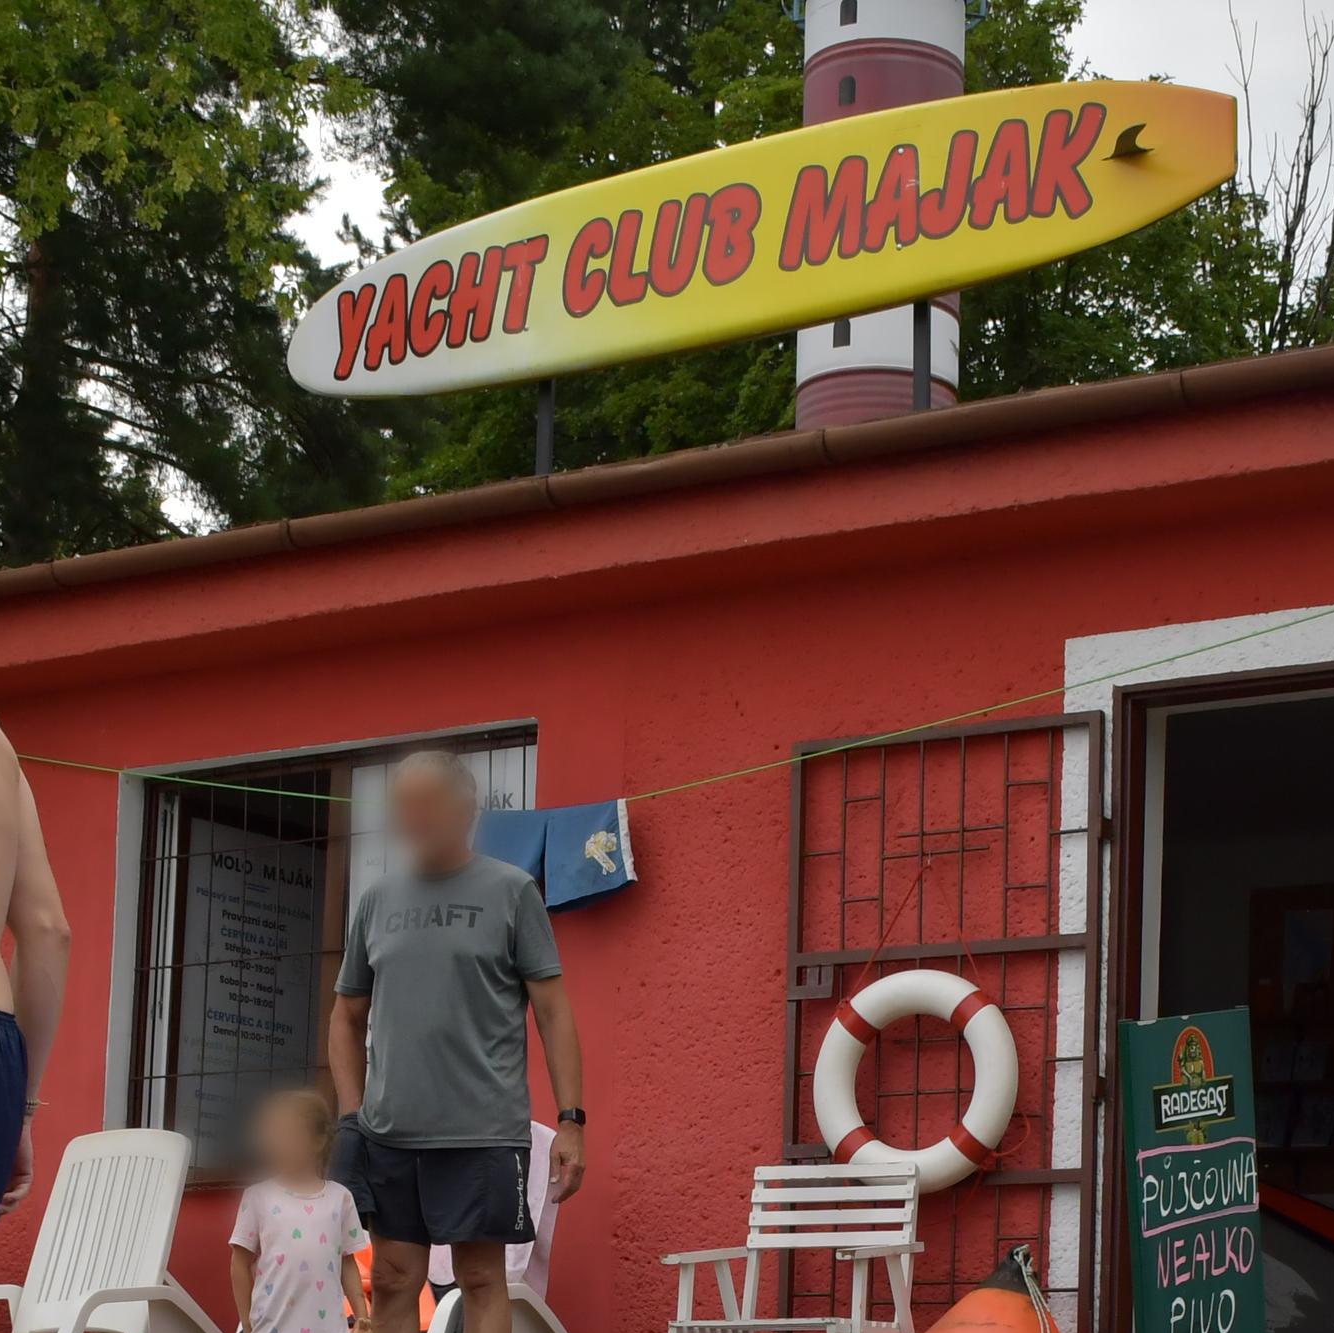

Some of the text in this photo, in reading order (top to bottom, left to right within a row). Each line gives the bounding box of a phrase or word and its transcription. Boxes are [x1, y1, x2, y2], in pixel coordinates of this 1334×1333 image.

[334, 101, 1108, 381] YACHT CLUB MAJAK
[212, 854, 253, 876] MOLO
[386, 904, 483, 935] CRAFT
[1161, 1084, 1228, 1123] RADEGAST
[1142, 1152, 1257, 1231] PŮJČOVNA
[1157, 1226, 1254, 1288] NEALKO
